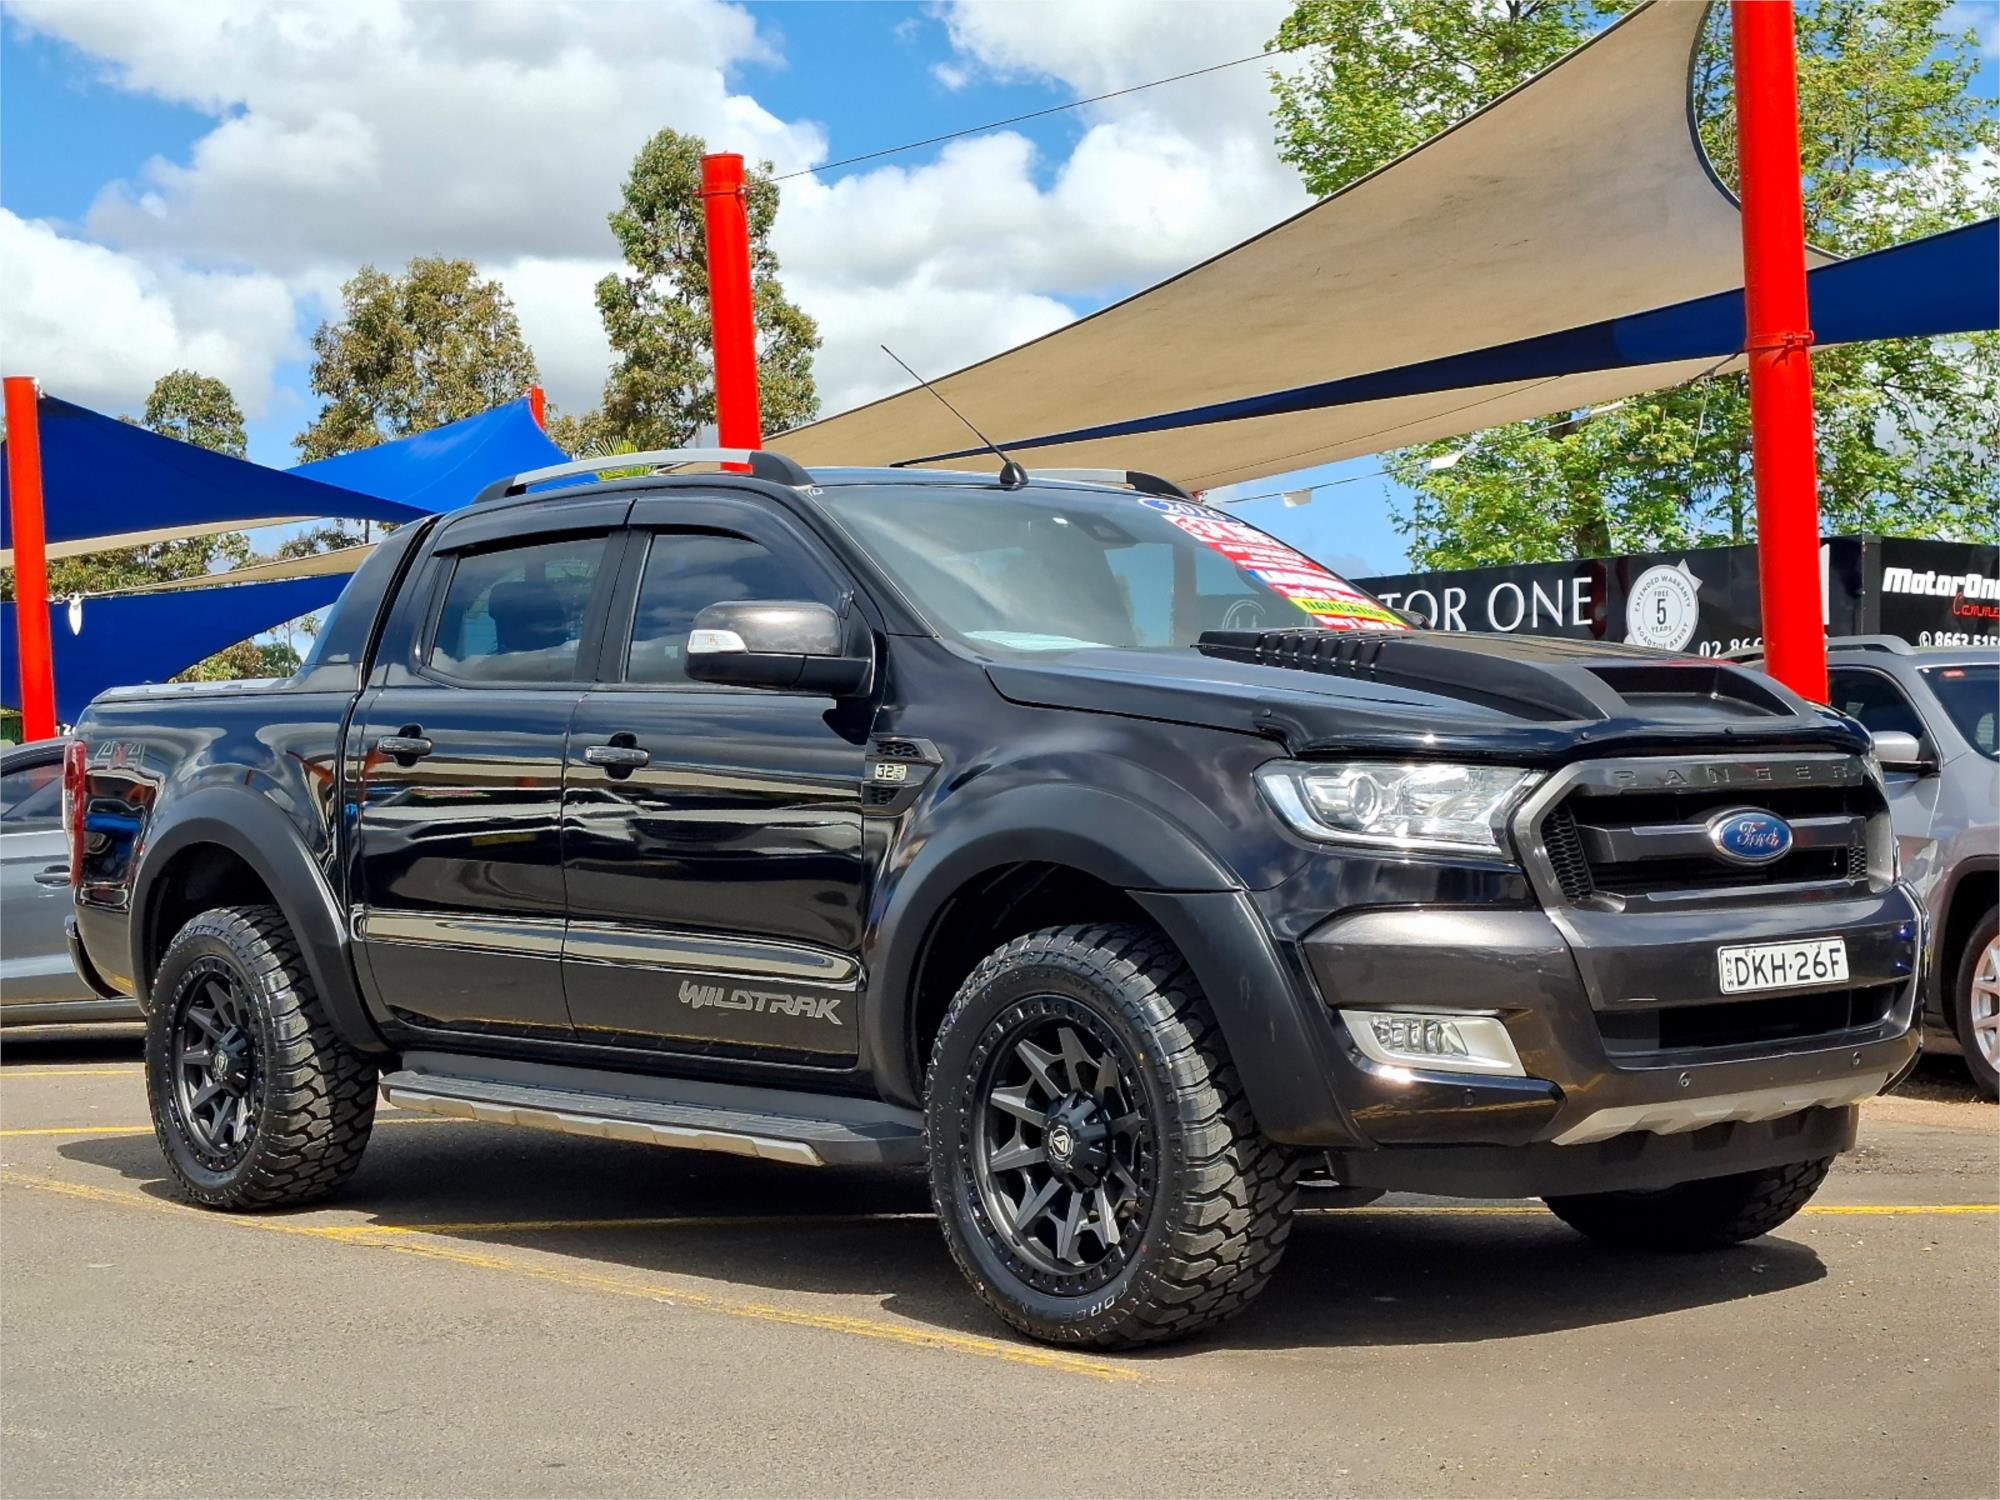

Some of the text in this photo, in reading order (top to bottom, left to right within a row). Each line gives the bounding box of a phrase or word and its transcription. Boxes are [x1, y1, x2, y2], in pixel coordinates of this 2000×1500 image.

[1488, 577, 1592, 632] ONE
[1656, 599, 1666, 625] 5
[1613, 764, 1849, 786] RANGER
[1737, 820, 1780, 848] Ford
[678, 980, 843, 1025] WILDTRAK
